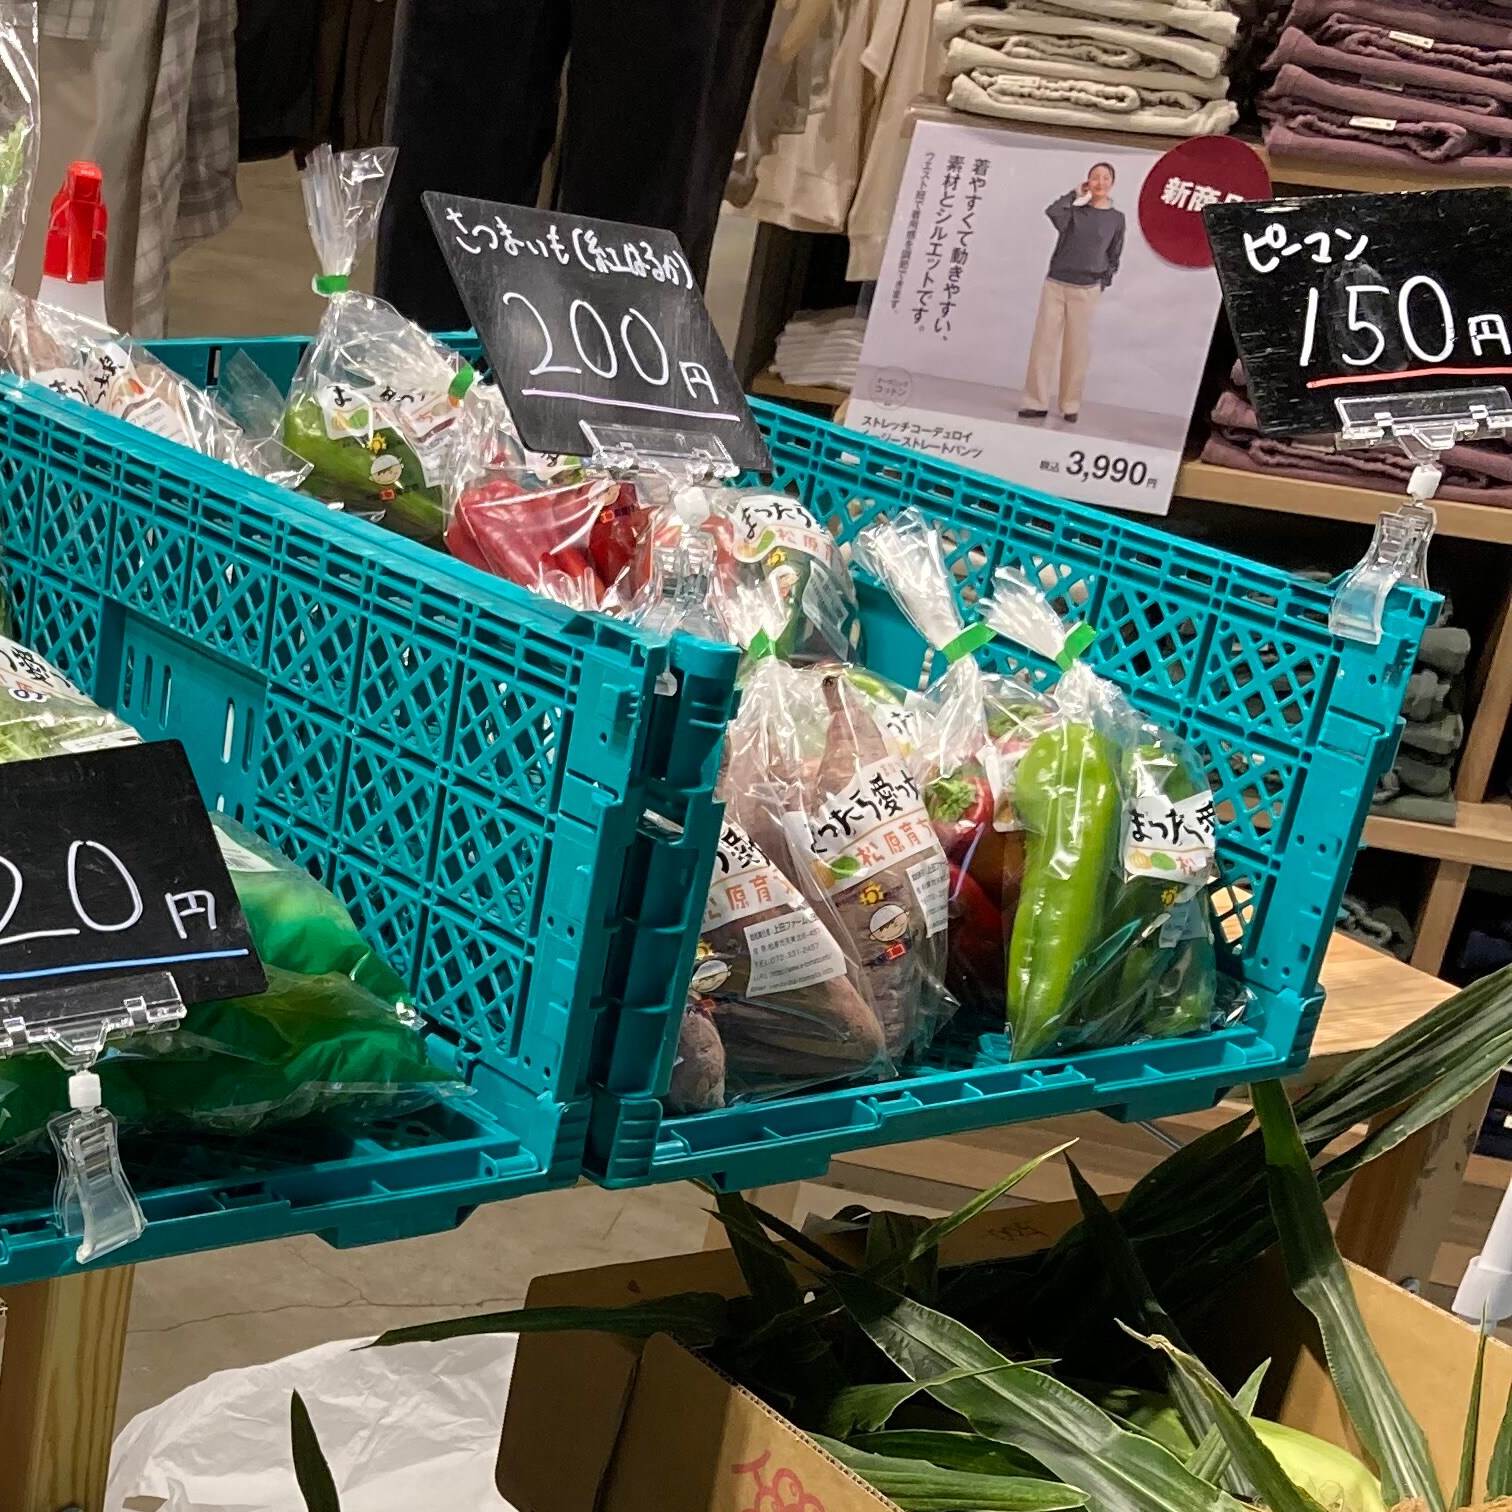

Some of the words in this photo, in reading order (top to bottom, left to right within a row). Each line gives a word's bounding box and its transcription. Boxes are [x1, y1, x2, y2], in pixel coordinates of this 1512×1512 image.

[912, 154, 966, 332] 素材とシルエットです。
[937, 158, 991, 342] 着やすくて動きやすい、
[1243, 223, 1369, 273] ピーマン
[502, 291, 720, 406] 200円
[1299, 275, 1512, 367] 150円
[861, 415, 974, 444] ストレッチコーデュロイ
[1065, 450, 1159, 489] 3,990円
